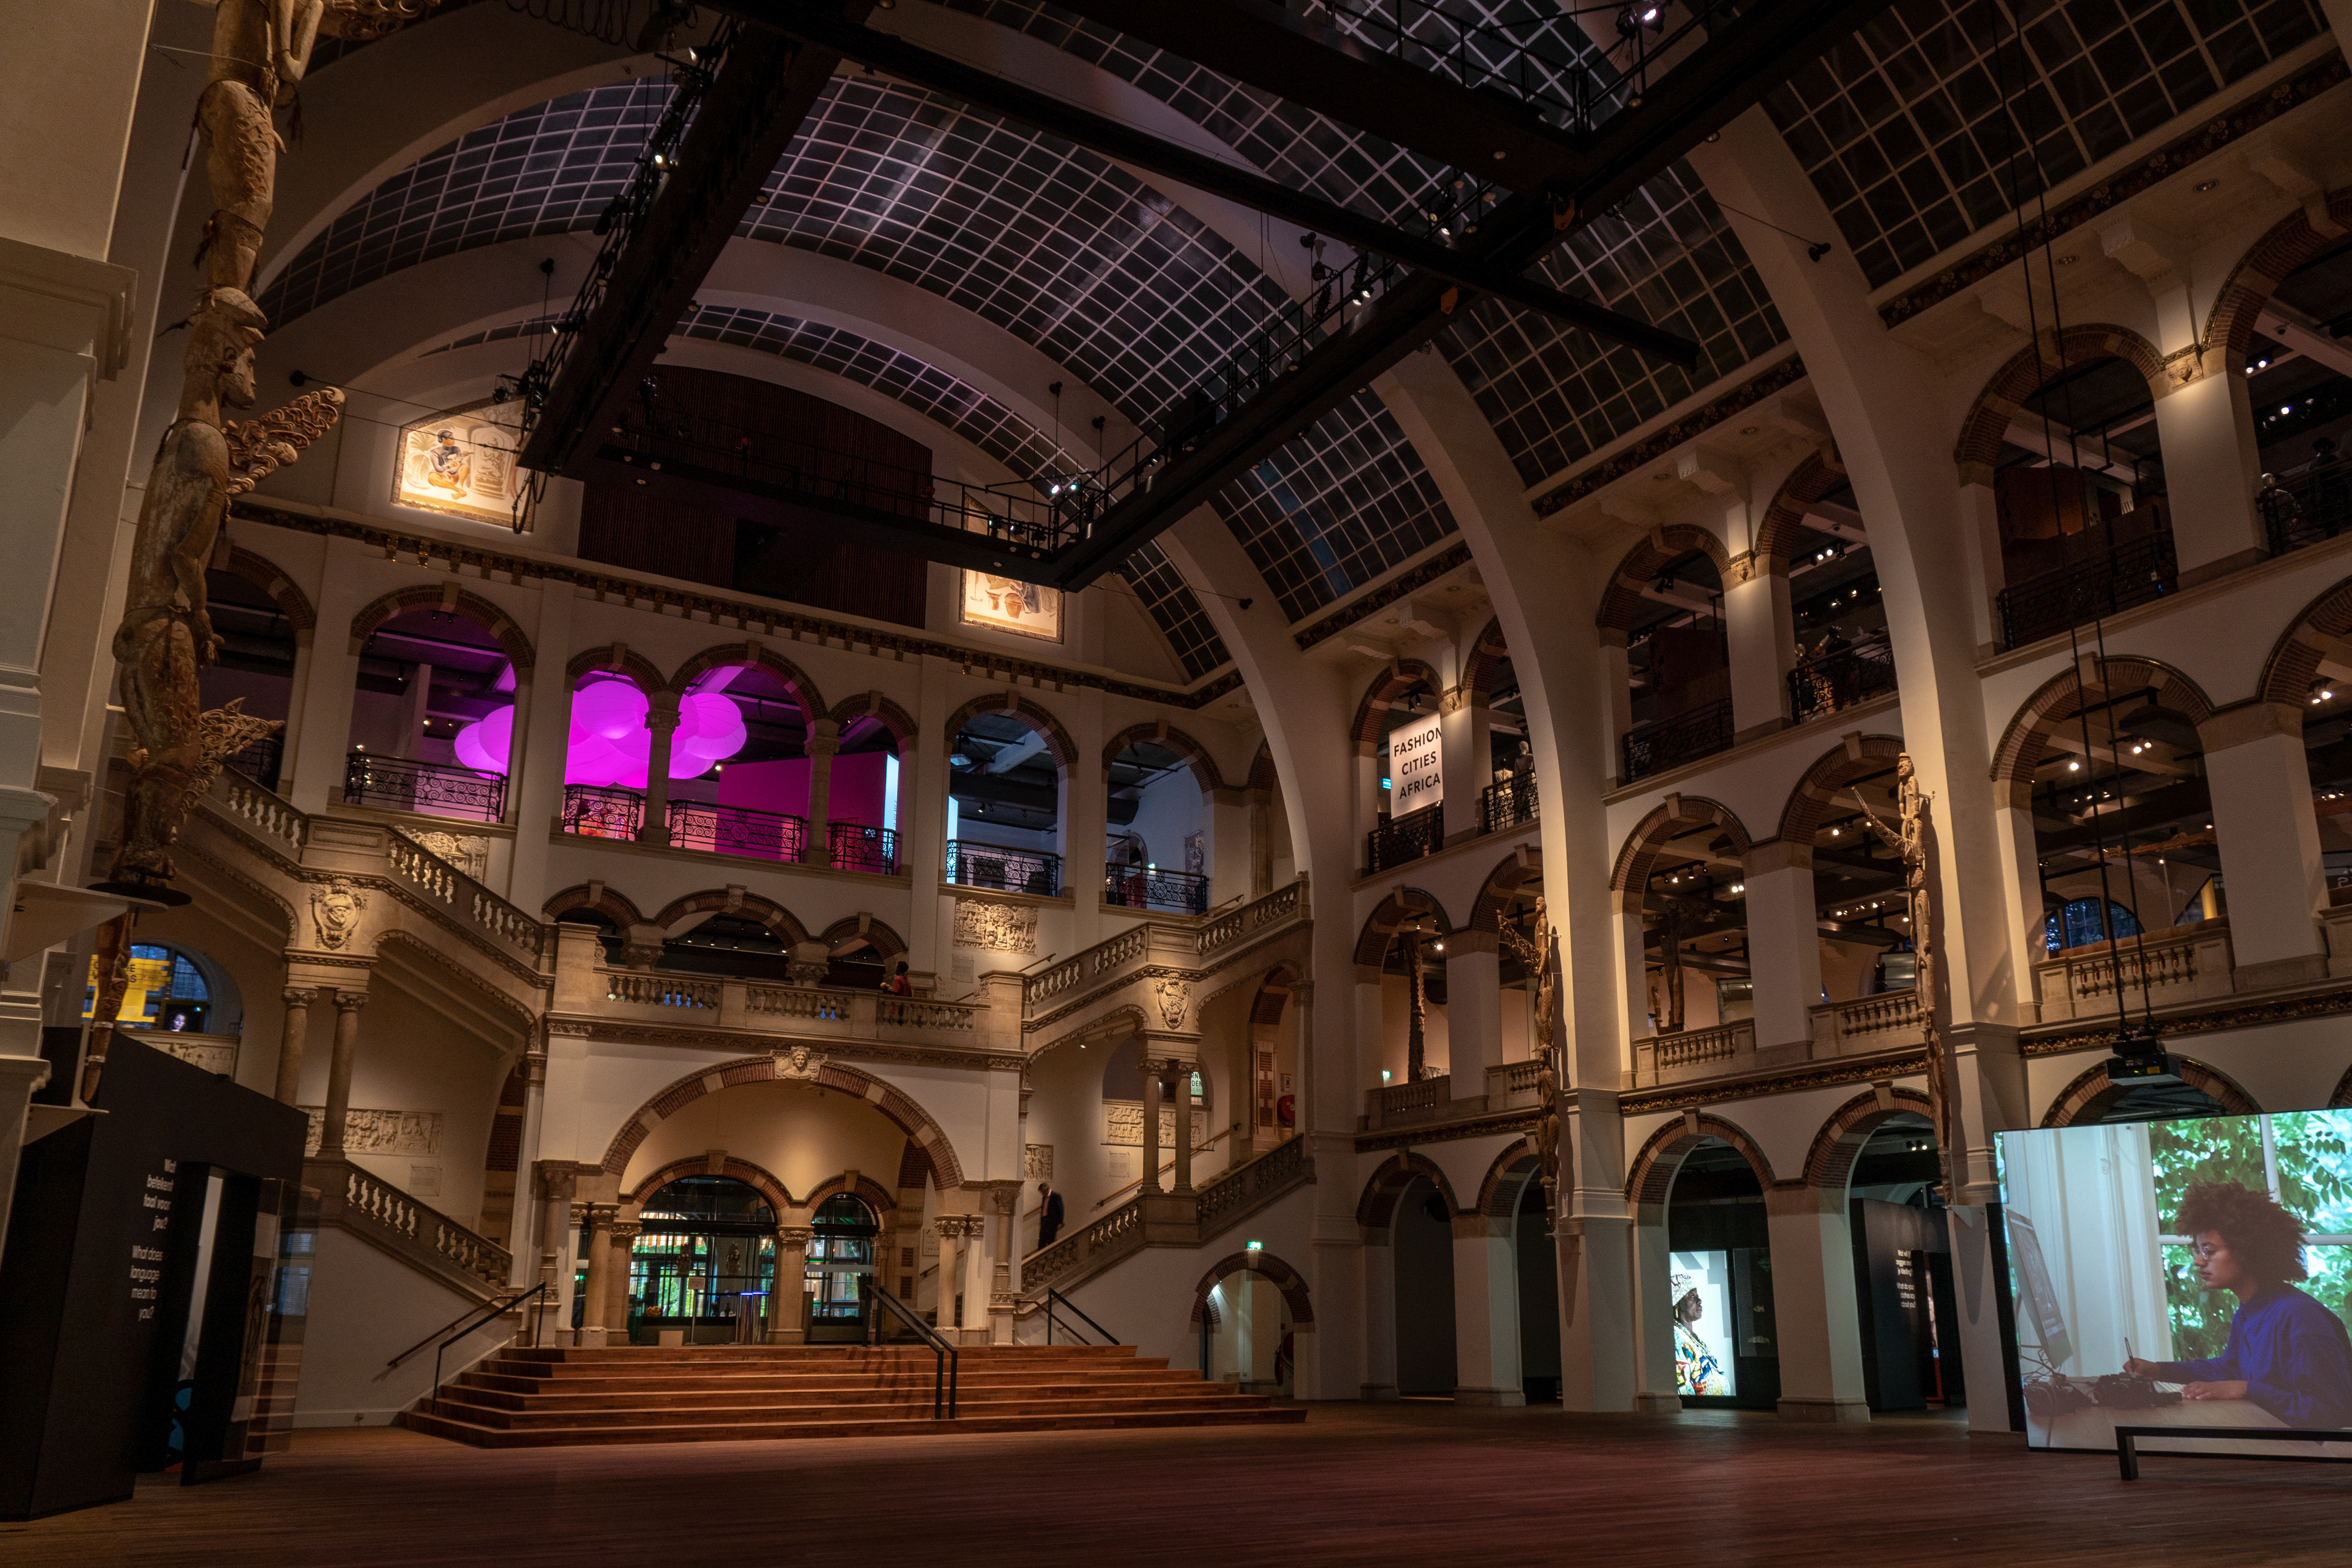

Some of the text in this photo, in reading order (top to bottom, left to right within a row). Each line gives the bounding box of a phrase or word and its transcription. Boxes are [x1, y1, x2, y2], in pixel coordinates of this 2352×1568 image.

[1394, 727, 1441, 757] FASHION
[1402, 751, 1436, 775] CITIES
[1399, 773, 1440, 799] AFRICA
[147, 1174, 174, 1191] betekent
[143, 1194, 171, 1210] taal voor
[153, 1215, 168, 1231] jou?
[132, 1245, 163, 1261] What does
[130, 1265, 160, 1283] language
[130, 1287, 157, 1299] mean to
[138, 1306, 154, 1322] you?
